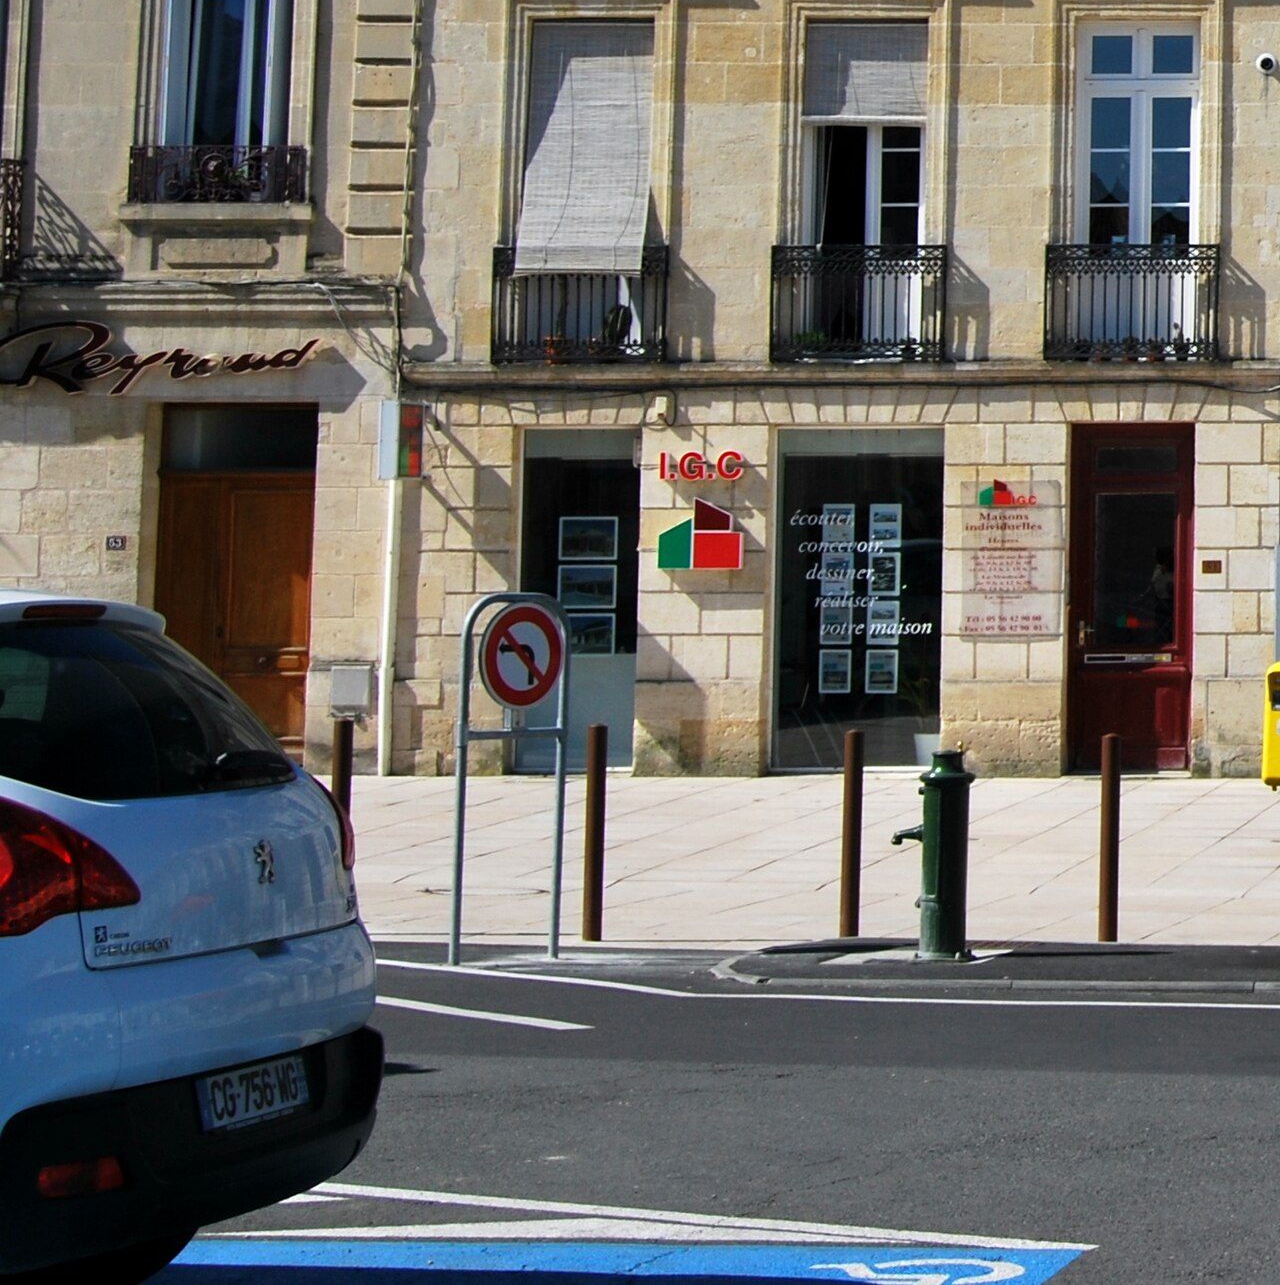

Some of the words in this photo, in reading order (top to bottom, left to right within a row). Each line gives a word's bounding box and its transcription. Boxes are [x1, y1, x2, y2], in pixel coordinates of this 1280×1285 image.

[659, 450, 744, 480] I.G.C
[965, 522, 1042, 531] individuelles
[979, 513, 1029, 521] Maisons
[798, 534, 884, 554] concevoir,
[806, 562, 876, 581] dessiner,
[814, 589, 879, 608] réaliser
[820, 622, 864, 635] votre
[869, 617, 932, 635] maison
[95, 936, 173, 957] PEUGEOT
[211, 1061, 299, 1122] CG-756-WG
